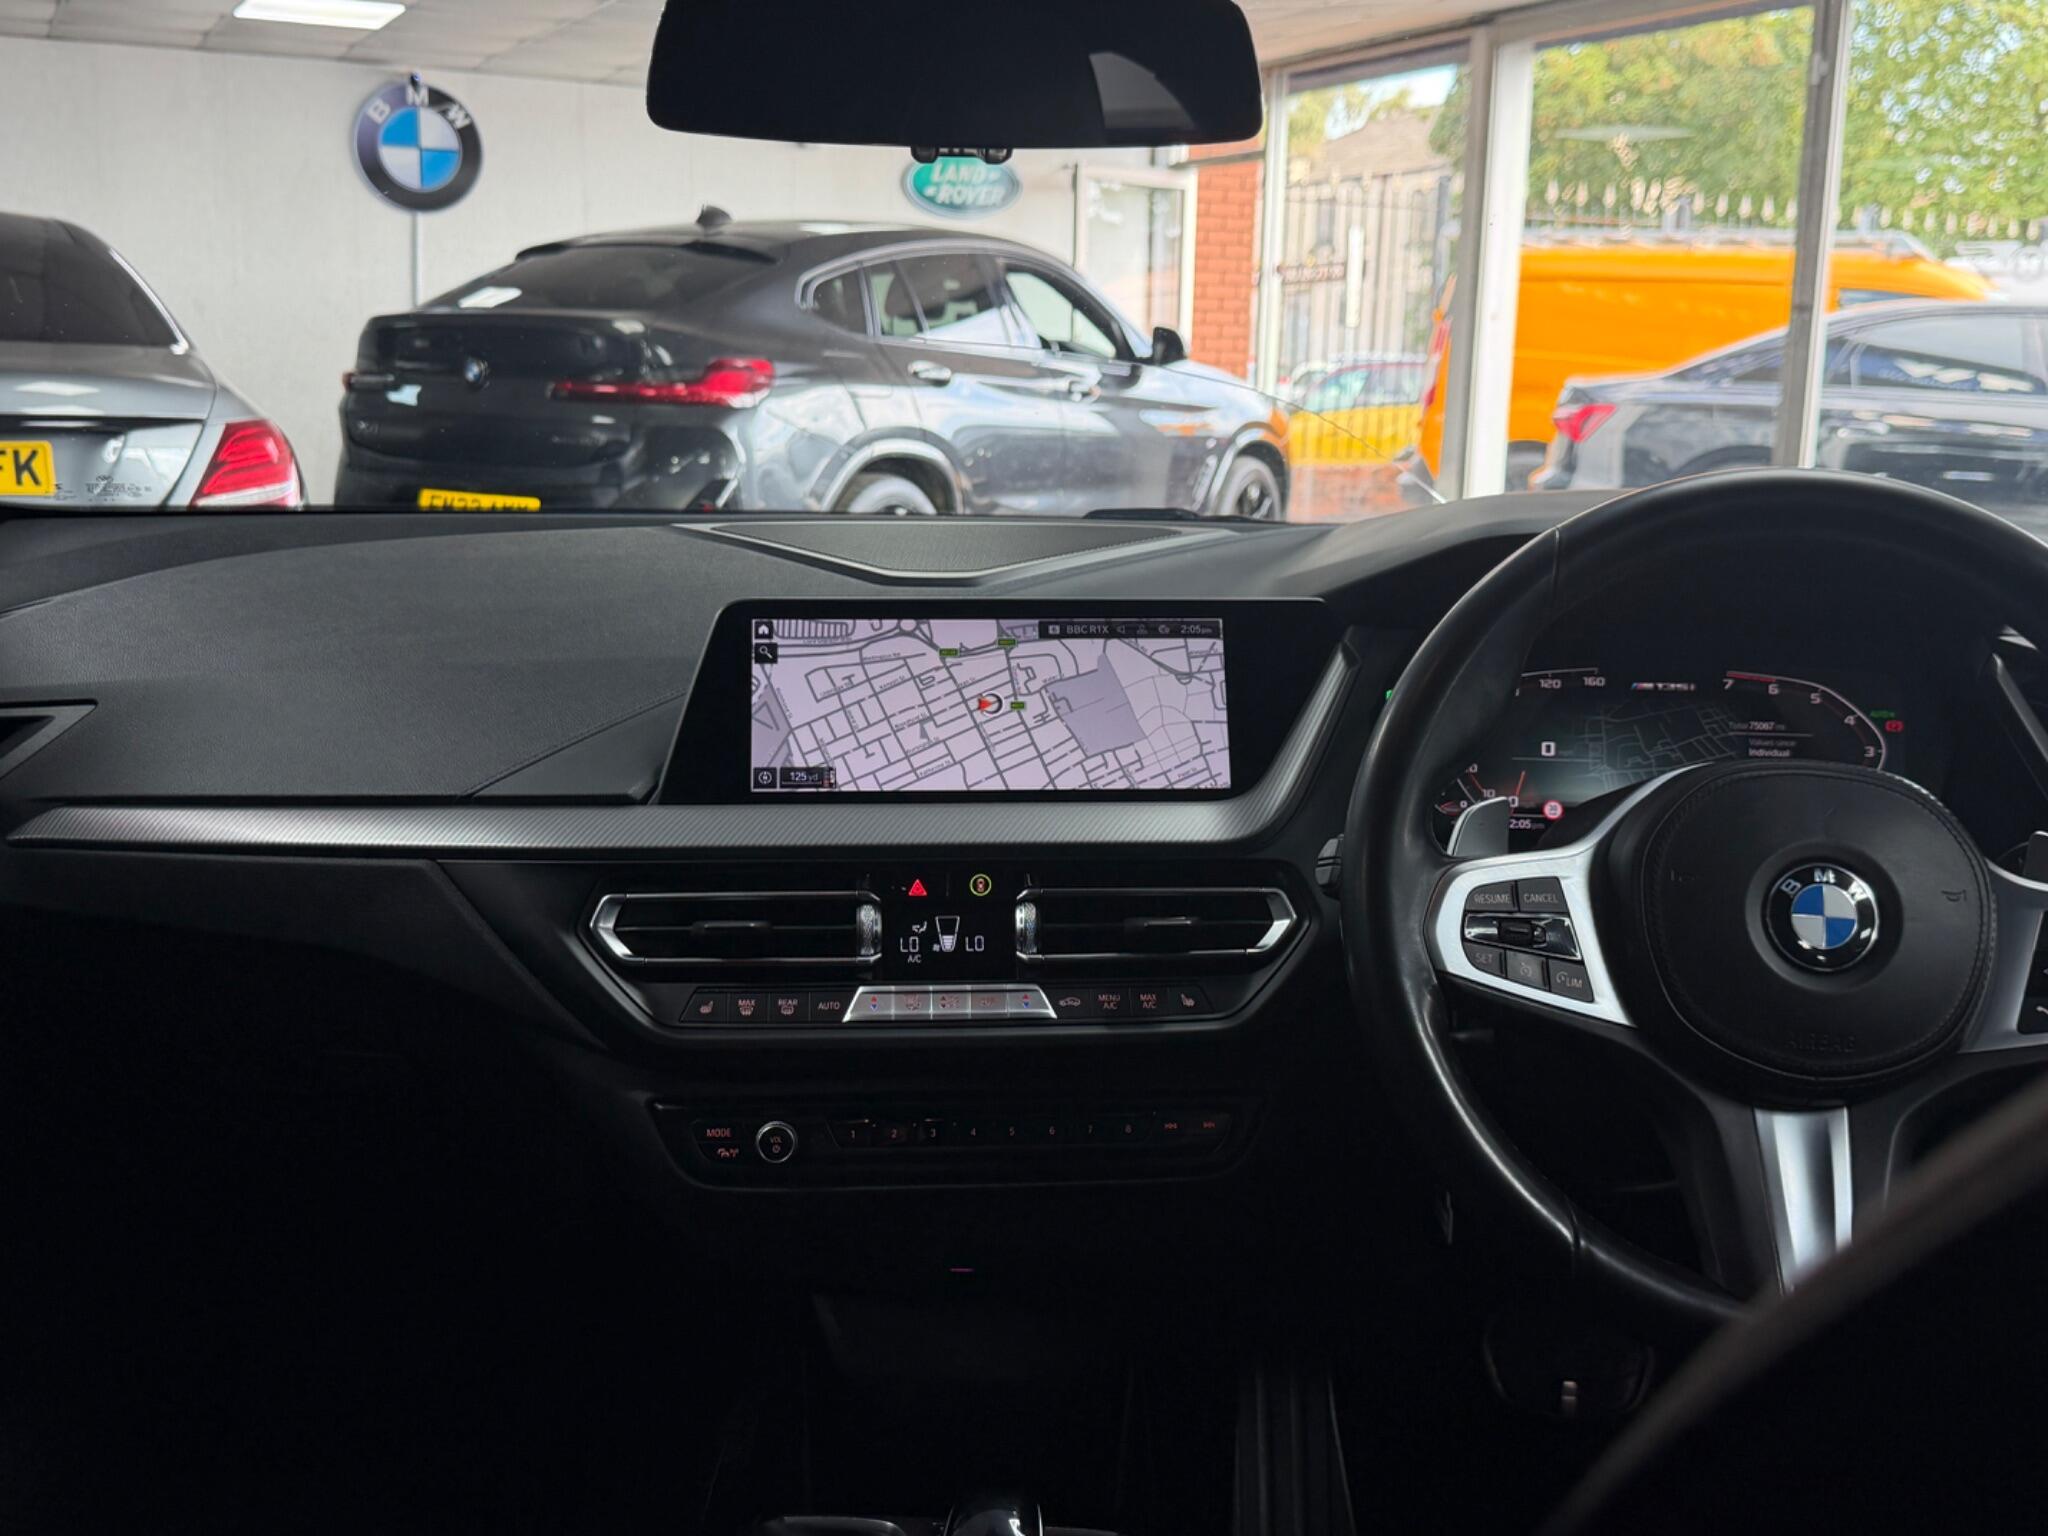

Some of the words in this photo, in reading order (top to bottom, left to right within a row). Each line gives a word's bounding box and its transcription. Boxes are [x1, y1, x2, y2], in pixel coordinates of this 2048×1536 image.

[367, 82, 471, 130] BMW
[931, 161, 987, 183] LAND
[935, 183, 1006, 206] ROVER
[1539, 679, 1562, 689] 120
[1583, 677, 1605, 686] 160
[1722, 679, 1735, 690] 7
[1767, 684, 1780, 695] 6
[1810, 693, 1822, 704] 5
[1844, 715, 1856, 726] 4
[1864, 746, 1875, 757] 3
[790, 772, 807, 781] 125
[1780, 867, 1870, 903] BMW
[1474, 893, 1510, 904] RESUME
[1524, 892, 1558, 904] CANCEL
[900, 936, 919, 952] LO
[965, 935, 985, 952] LO
[907, 954, 922, 963] A/C
[1476, 953, 1493, 964] SET
[1565, 978, 1583, 989] LIM
[817, 1001, 841, 1011] AUTO
[706, 1128, 731, 1138] MODE
